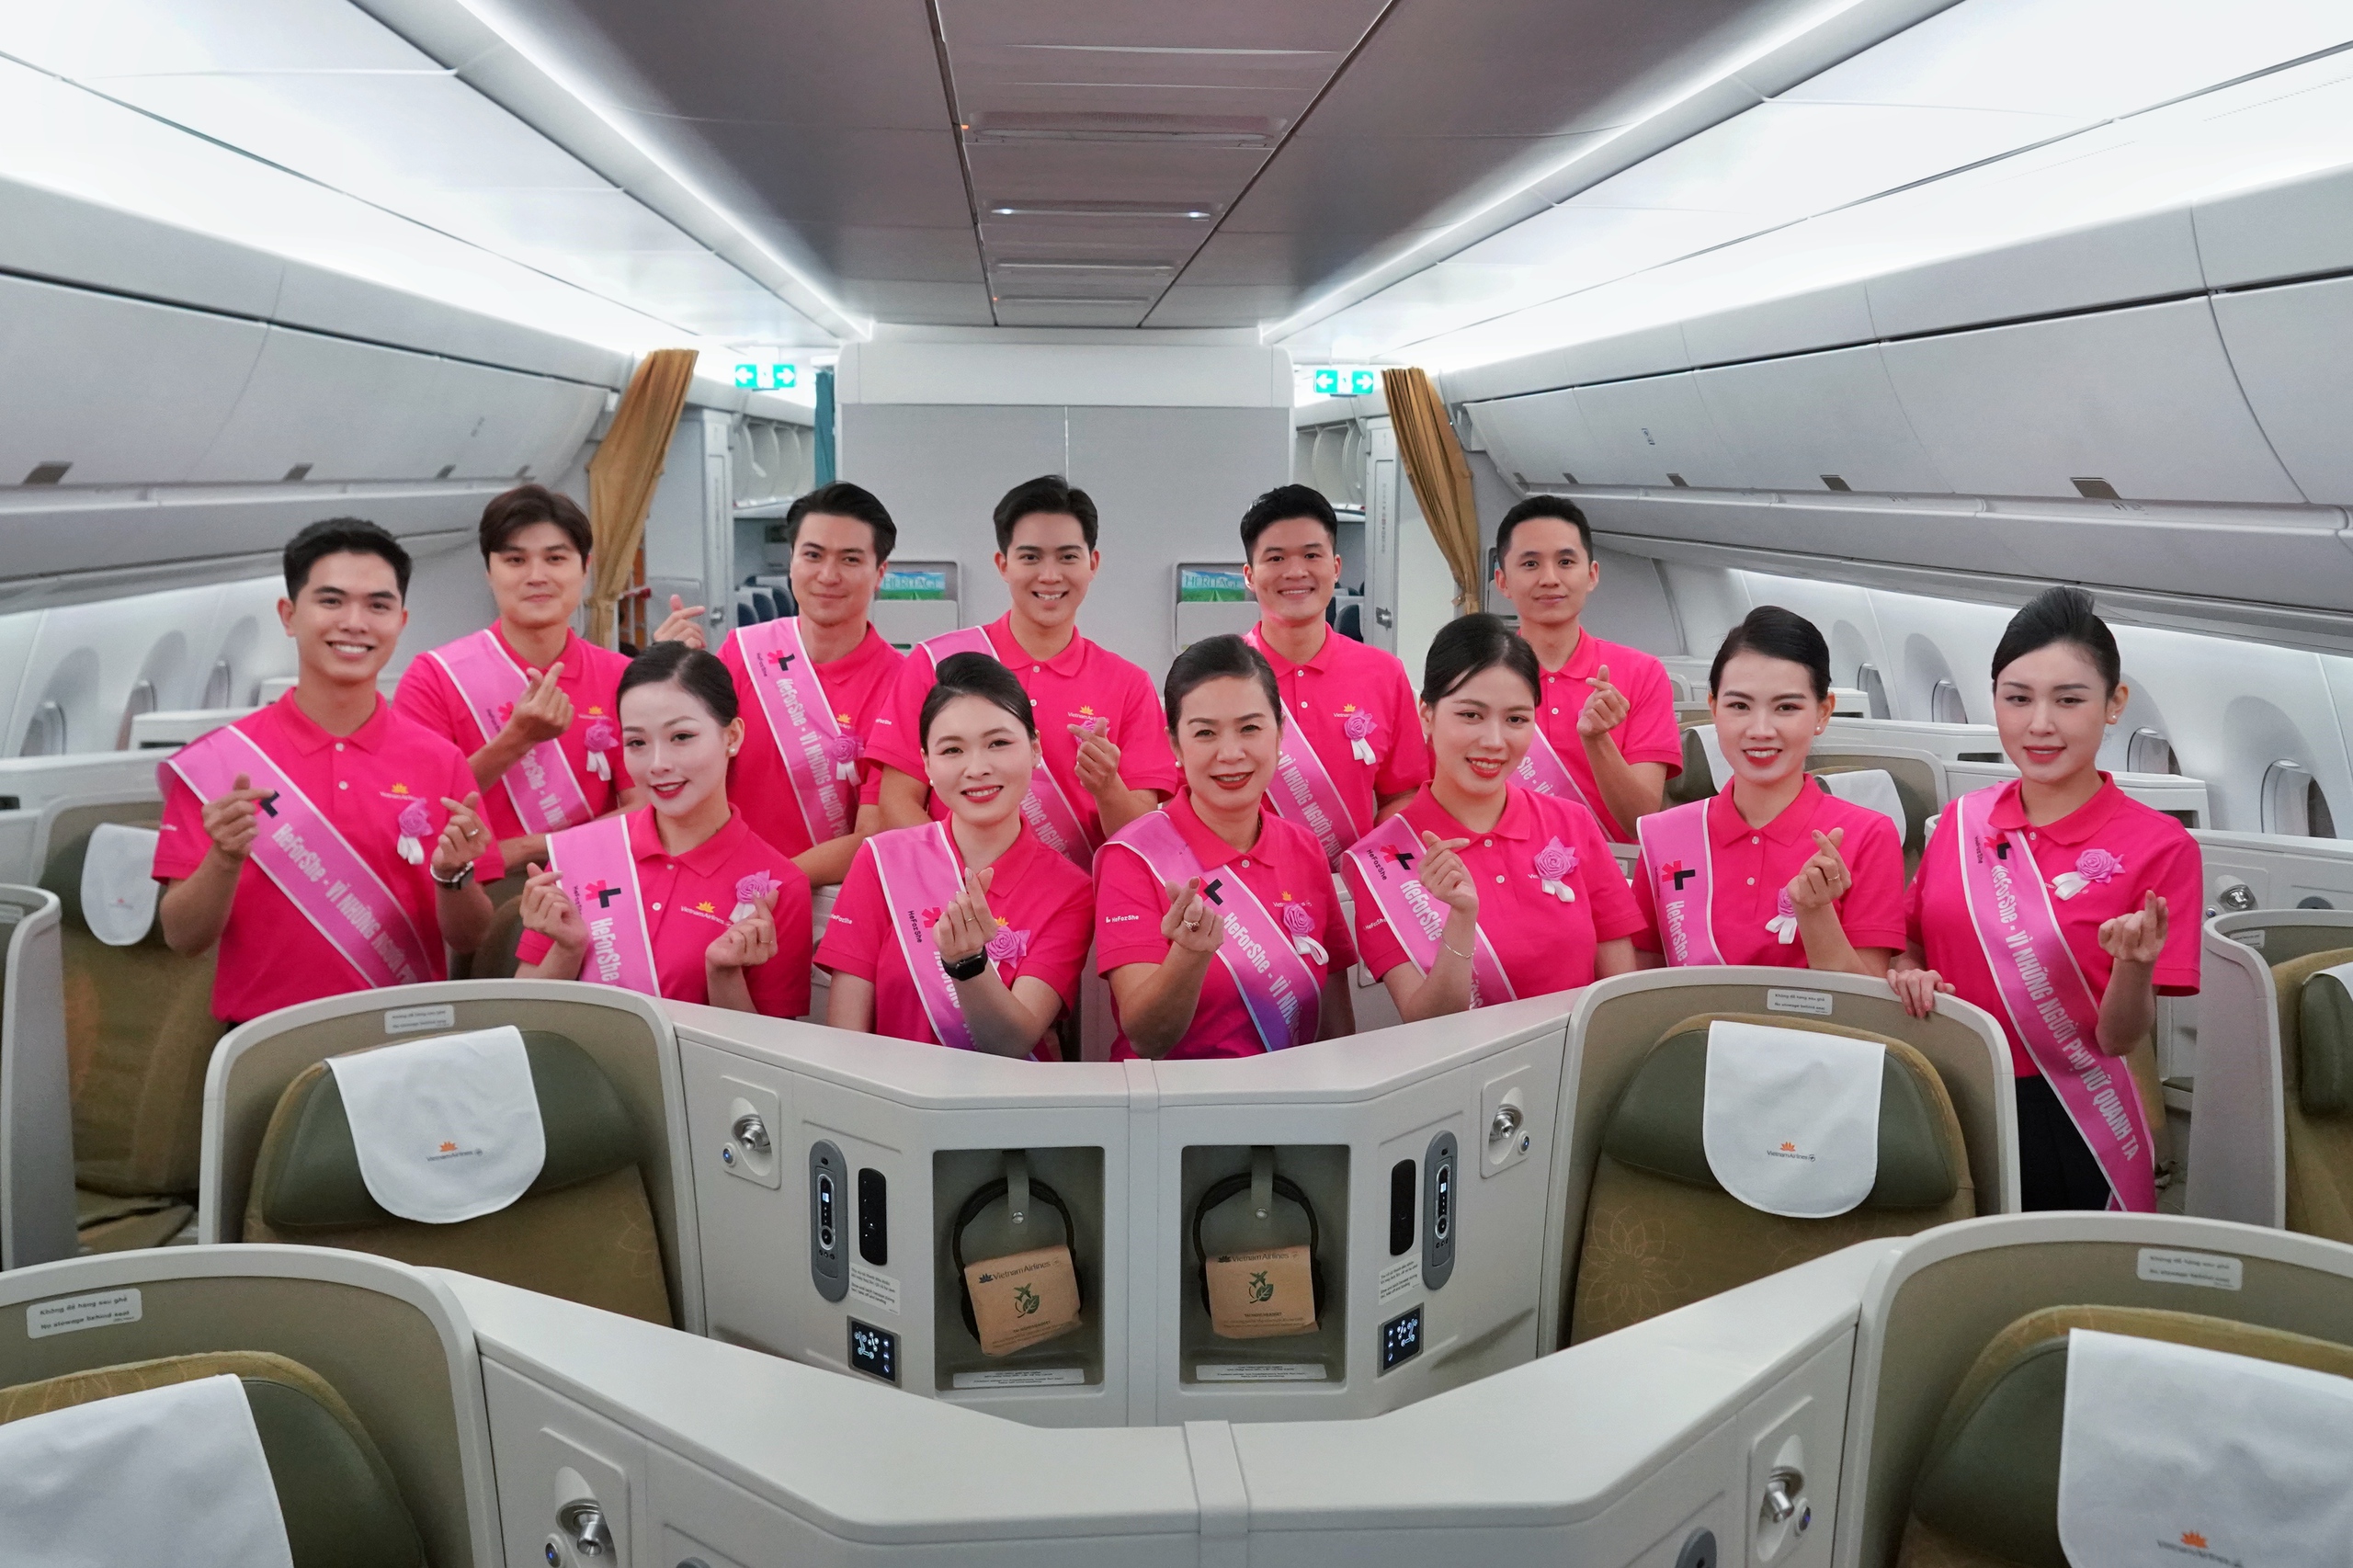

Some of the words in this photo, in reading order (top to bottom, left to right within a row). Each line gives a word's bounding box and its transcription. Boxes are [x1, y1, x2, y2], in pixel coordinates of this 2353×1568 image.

[1185, 575, 1238, 588] HERITAGE
[776, 678, 807, 727] HeForShe
[1281, 766, 1313, 806] NHỮNG
[1302, 801, 1333, 837] NGƯỜI
[271, 823, 327, 882] HeForShe
[1366, 848, 1387, 881] HeForShe
[1400, 879, 1444, 942] HeForShe
[1991, 865, 2018, 925] HeForShe
[590, 916, 622, 983] HeForShe
[908, 910, 923, 943] HeForShe
[1665, 900, 1688, 962] HeForShe
[2005, 929, 2033, 949] VÌ
[1223, 912, 1271, 974] HeForShe
[1268, 974, 1292, 998] VÌ
[2012, 946, 2054, 1002] NHỮNG
[2036, 996, 2079, 1045] NGƯỜI
[2063, 1037, 2097, 1073] PHỤ
[2080, 1064, 2112, 1092] NỮ
[2093, 1087, 2133, 1142] QUANH
[2121, 1134, 2140, 1162] TA
